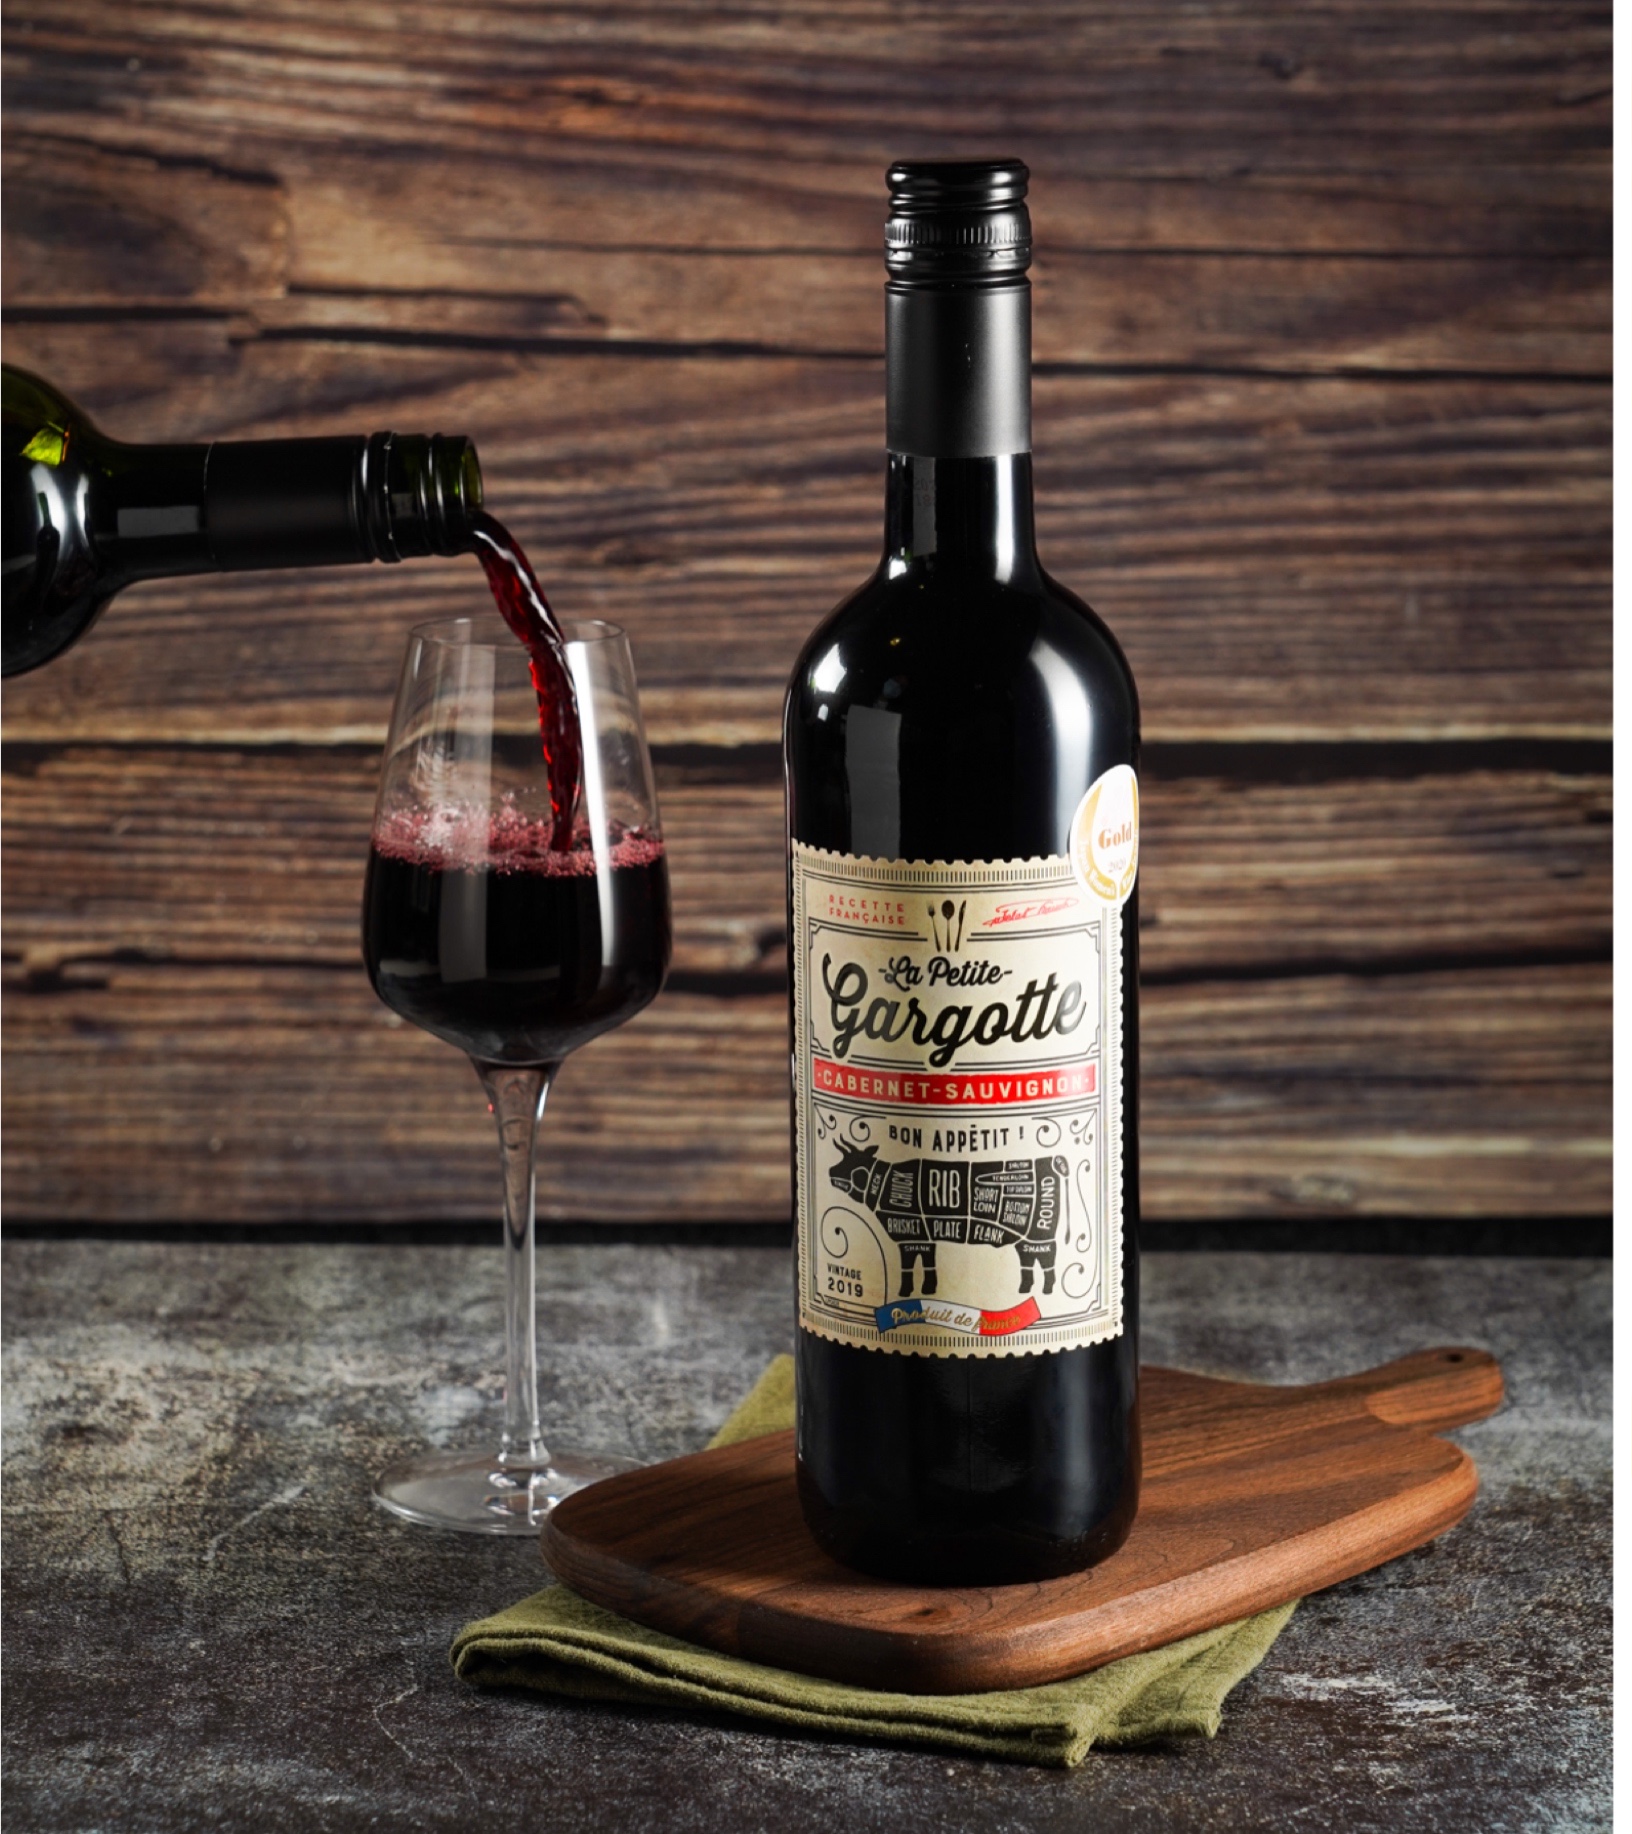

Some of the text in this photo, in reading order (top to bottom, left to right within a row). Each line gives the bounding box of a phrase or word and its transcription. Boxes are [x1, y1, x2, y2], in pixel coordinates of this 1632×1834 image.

[1098, 821, 1132, 849] Gold
[829, 894, 904, 912] RECETTE
[829, 907, 905, 925] FRANÇAISE
[822, 952, 1087, 1068] Gargotte
[889, 1125, 922, 1149] BON
[871, 1173, 882, 1196] NECK
[889, 1170, 914, 1208] CHUCK
[929, 1169, 961, 1208] RIB
[974, 1187, 999, 1203] SHORT
[1037, 1176, 1056, 1230] ROUND
[973, 1202, 996, 1214] LOIN
[887, 1218, 921, 1235] BRISKET
[933, 1220, 962, 1239] PLATE
[974, 1224, 1005, 1244] FLANK
[1022, 1244, 1051, 1253] SHANK
[827, 1263, 862, 1280] VINTAGE
[827, 1276, 864, 1297] 2019
[891, 1307, 953, 1324] Produit
[953, 1313, 972, 1326] de
